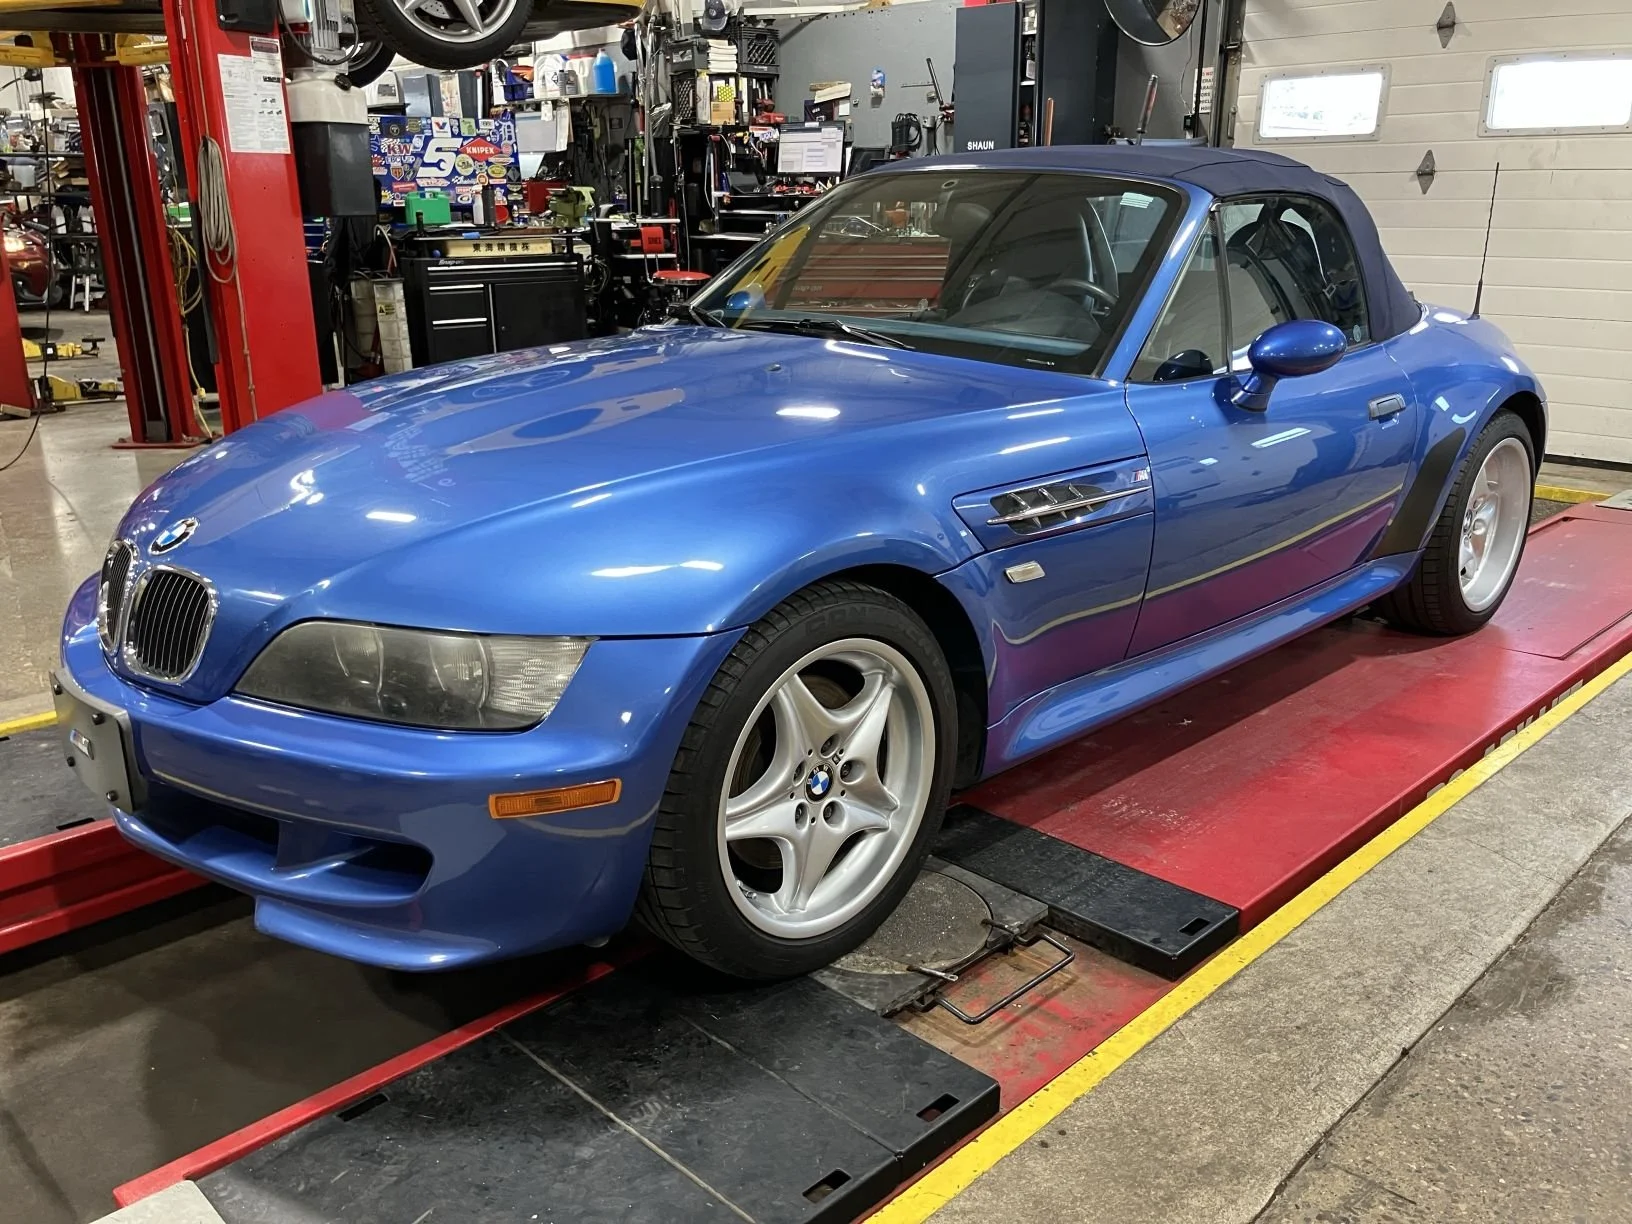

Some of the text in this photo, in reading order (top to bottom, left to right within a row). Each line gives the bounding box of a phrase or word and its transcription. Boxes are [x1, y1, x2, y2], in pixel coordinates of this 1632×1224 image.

[466, 146, 495, 154] KNIPEX
[967, 140, 995, 151] SHAUN
[416, 137, 464, 178] 5
